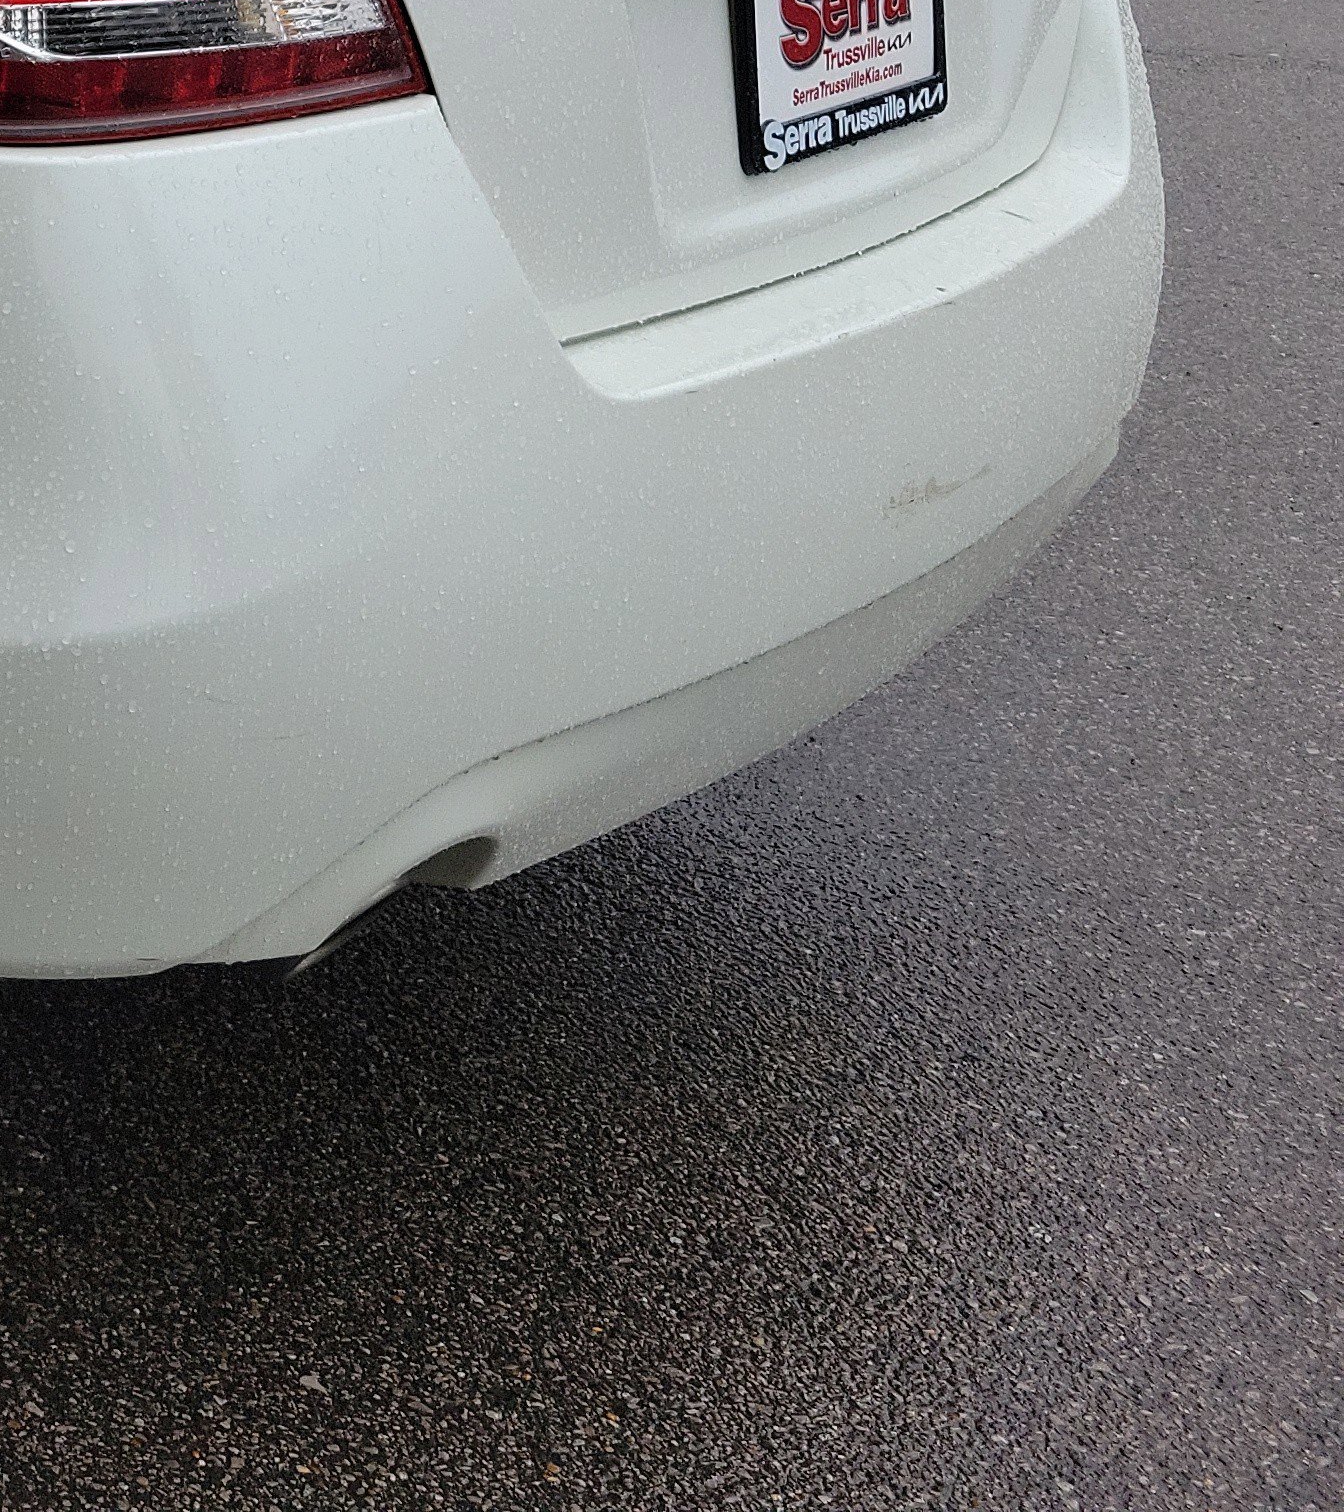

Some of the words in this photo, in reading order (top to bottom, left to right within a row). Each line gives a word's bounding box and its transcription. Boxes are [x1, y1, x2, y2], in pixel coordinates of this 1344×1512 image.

[823, 36, 886, 71] Trussville
[793, 62, 903, 106] SerraTrussvilleKia.com
[763, 115, 833, 171] Serra
[835, 94, 906, 138] Trussville
